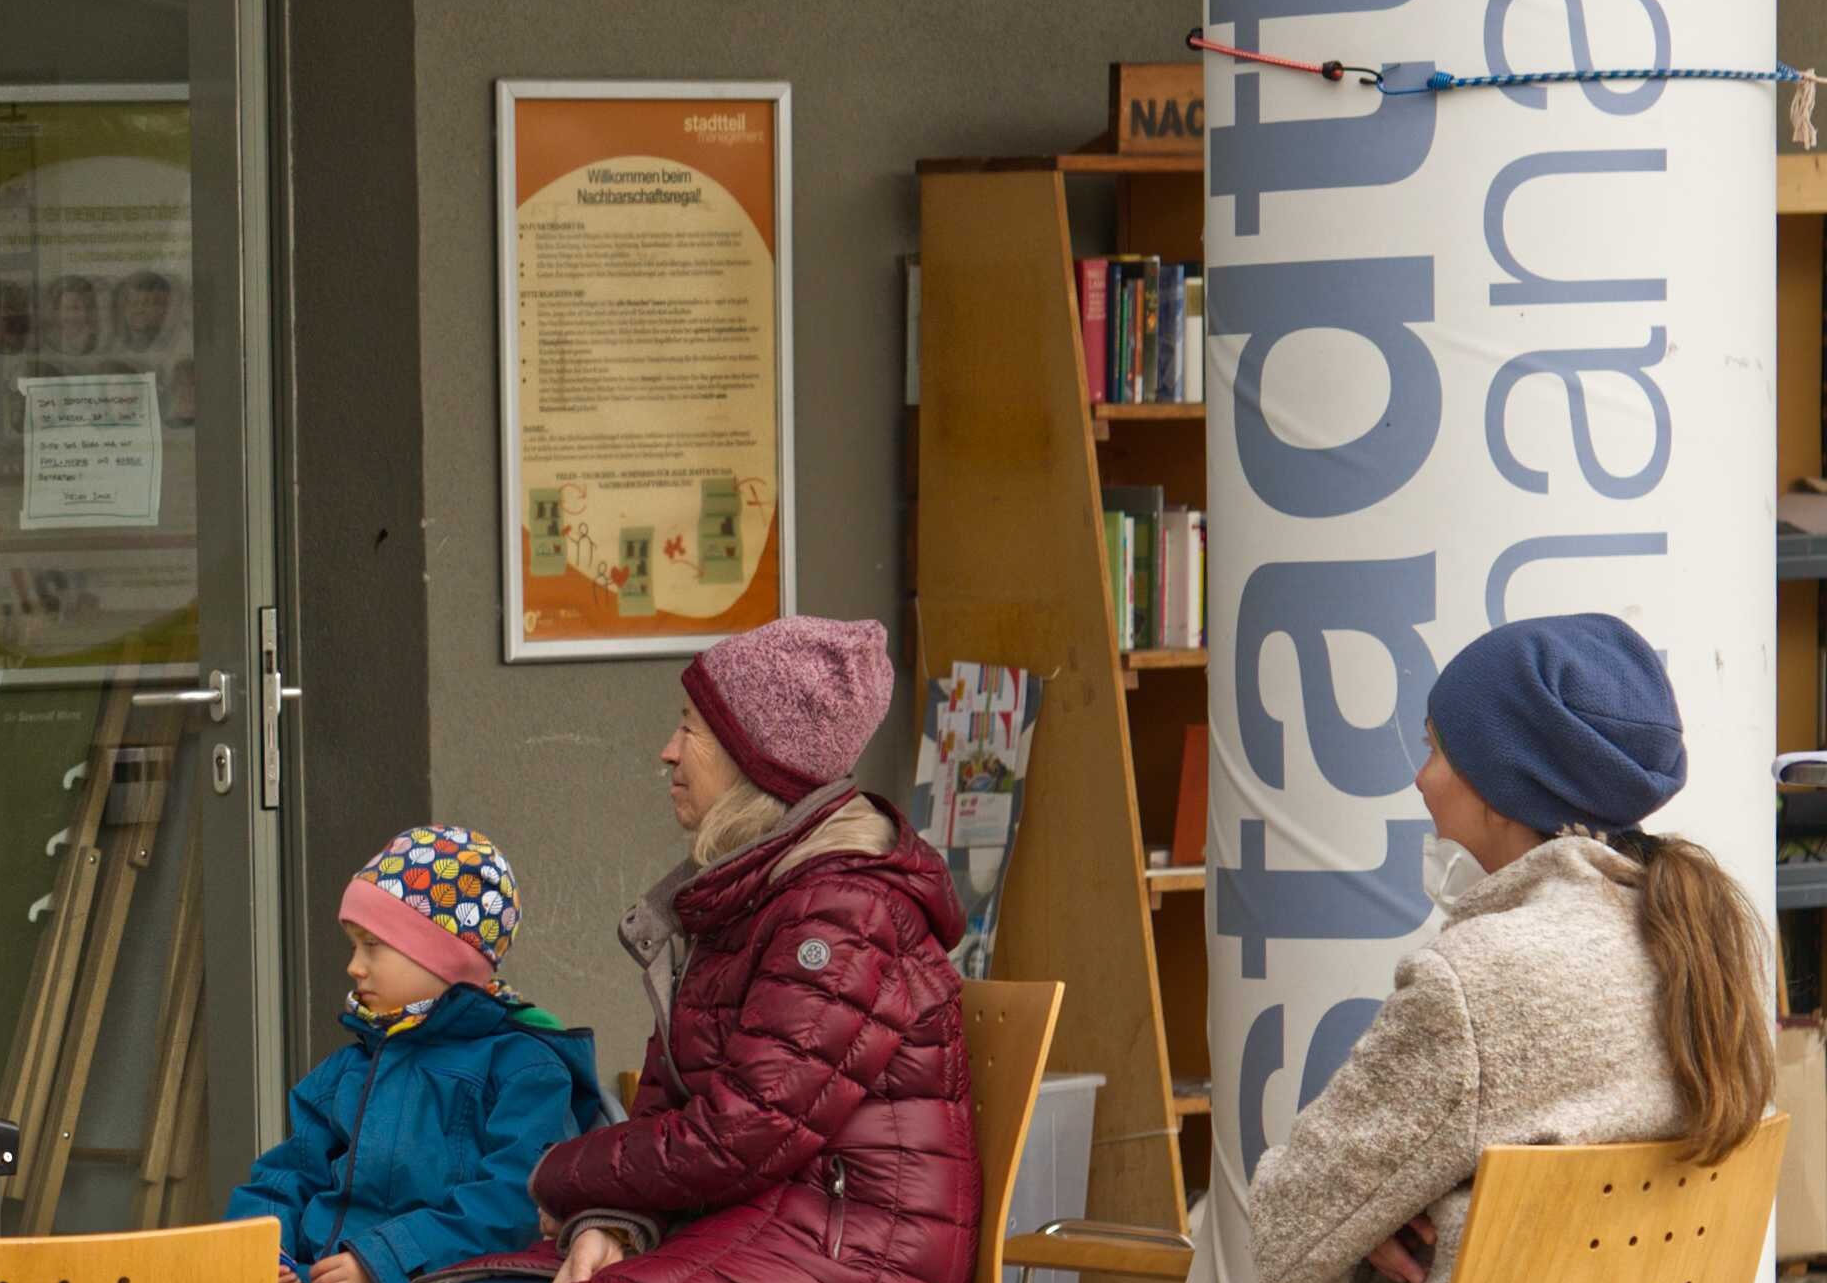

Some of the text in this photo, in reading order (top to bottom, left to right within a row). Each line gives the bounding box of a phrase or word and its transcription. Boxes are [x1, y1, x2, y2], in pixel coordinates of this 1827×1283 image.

[683, 113, 747, 133] stadtteil
[587, 167, 692, 184] Willkommen beim
[576, 187, 702, 207] Nachbarschaftsregal!
